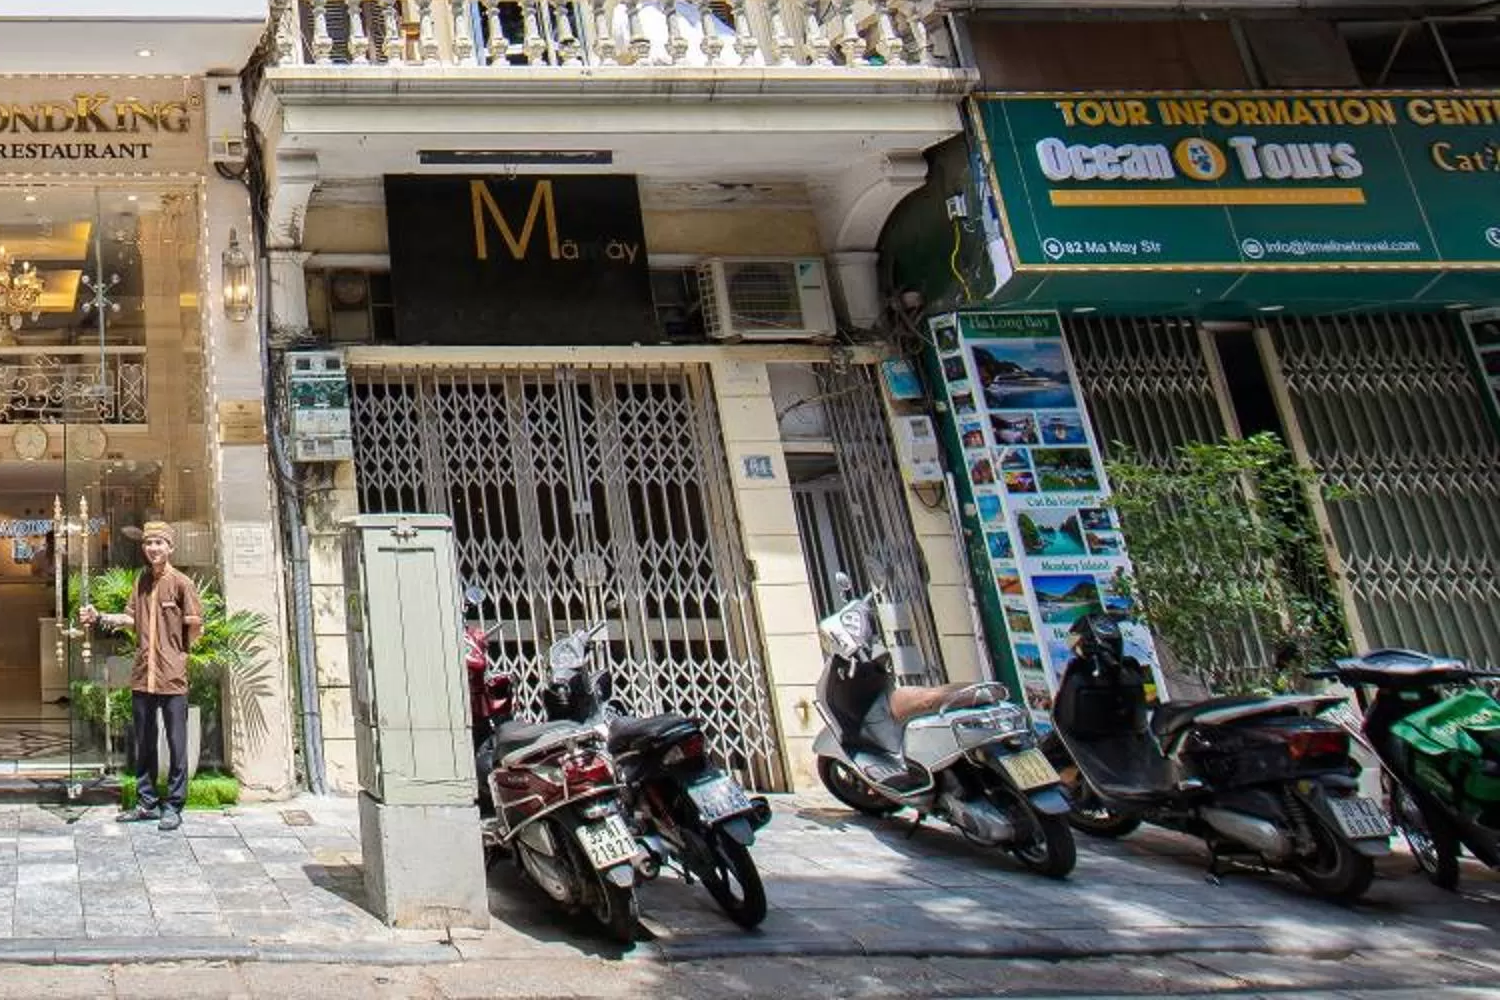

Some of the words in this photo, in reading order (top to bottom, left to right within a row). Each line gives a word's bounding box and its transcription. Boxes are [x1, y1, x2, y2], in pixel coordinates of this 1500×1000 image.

[1055, 100, 1152, 126] TOUR
[1157, 99, 1397, 126] INFORMATION
[1036, 137, 1176, 181] Ocean
[1228, 135, 1364, 181] Tours
[1065, 241, 1083, 253] 82
[1084, 241, 1107, 253] Ma
[1109, 241, 1137, 255] May
